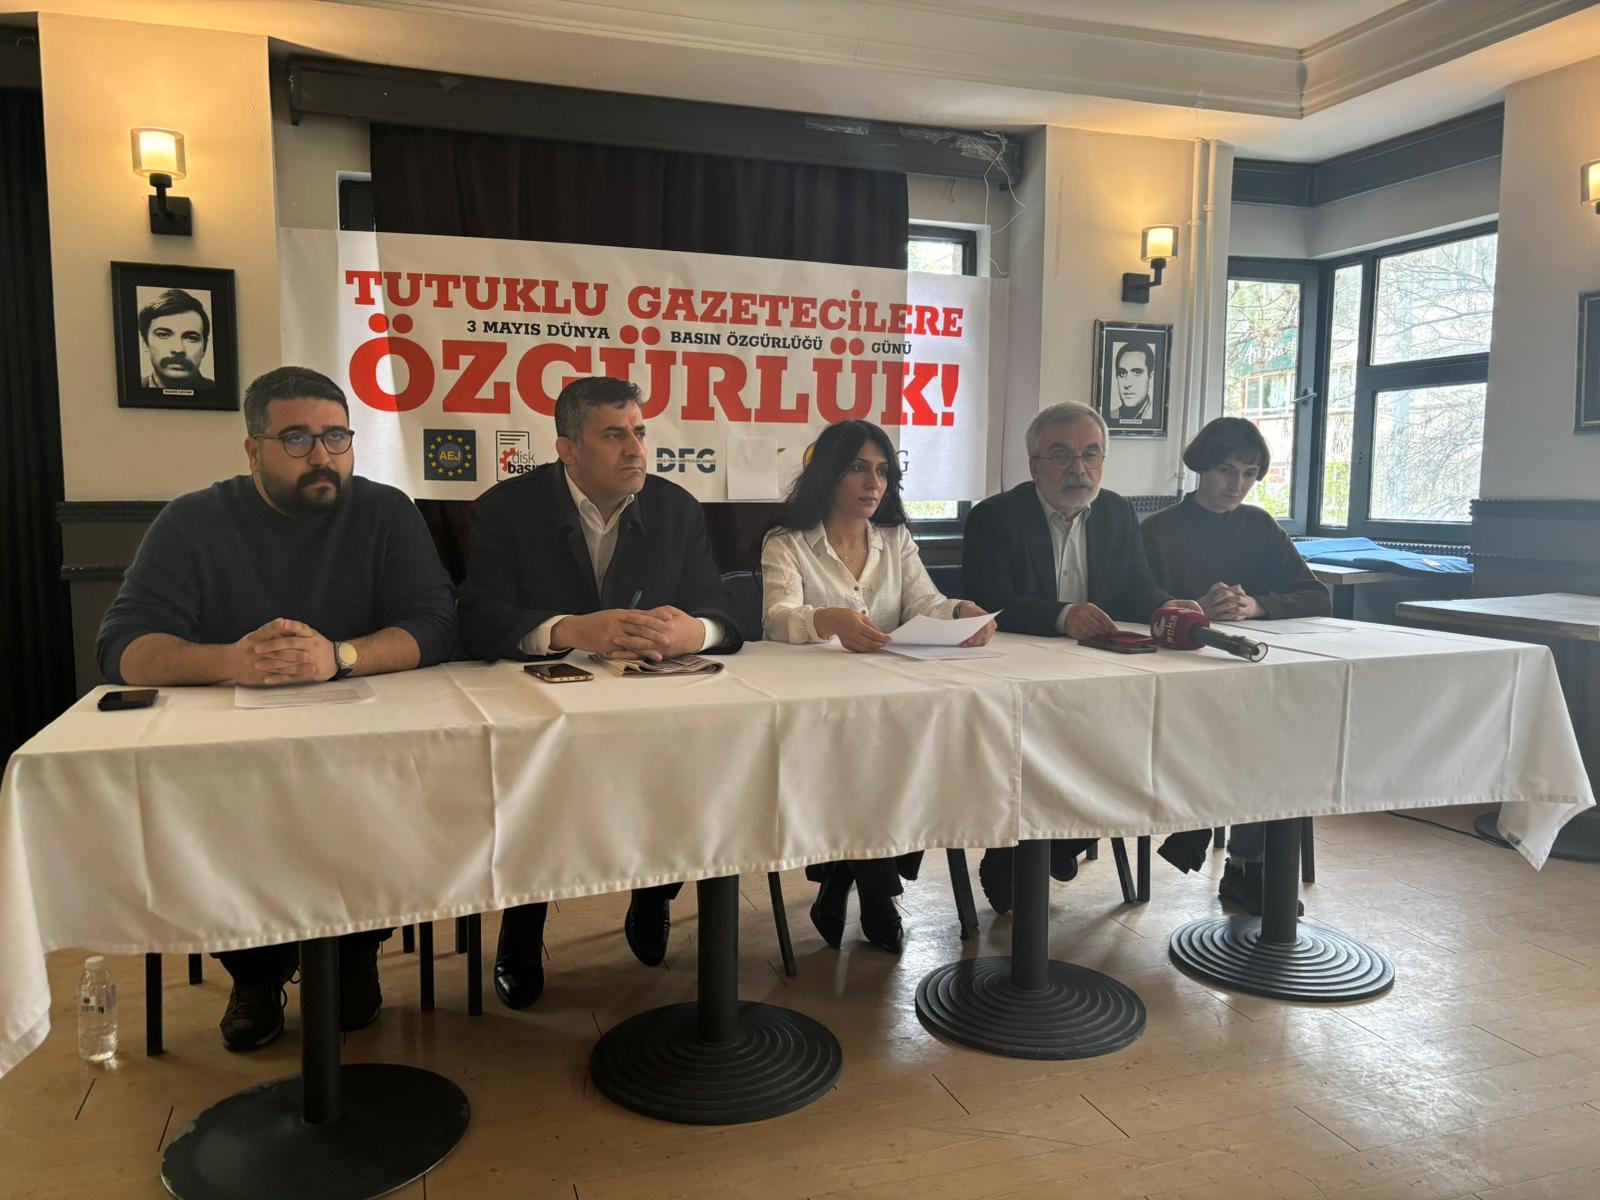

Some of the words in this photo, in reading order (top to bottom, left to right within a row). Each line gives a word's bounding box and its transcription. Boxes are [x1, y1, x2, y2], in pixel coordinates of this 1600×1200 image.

[345, 270, 608, 317] TUTUKLU
[627, 285, 964, 337] GAZETECİLERE
[467, 320, 477, 332] 3
[483, 321, 541, 336] MAYIS
[547, 322, 610, 339] DÜNYA
[670, 331, 721, 345] BASIN
[727, 331, 823, 350] ÖZGÜRLÜĞÜ
[871, 340, 912, 355] GÜNÜ
[349, 312, 960, 427] ÖZGÜRLÜK!
[439, 450, 461, 461] AEJ
[511, 450, 535, 464] disk
[656, 447, 716, 473] DFG
